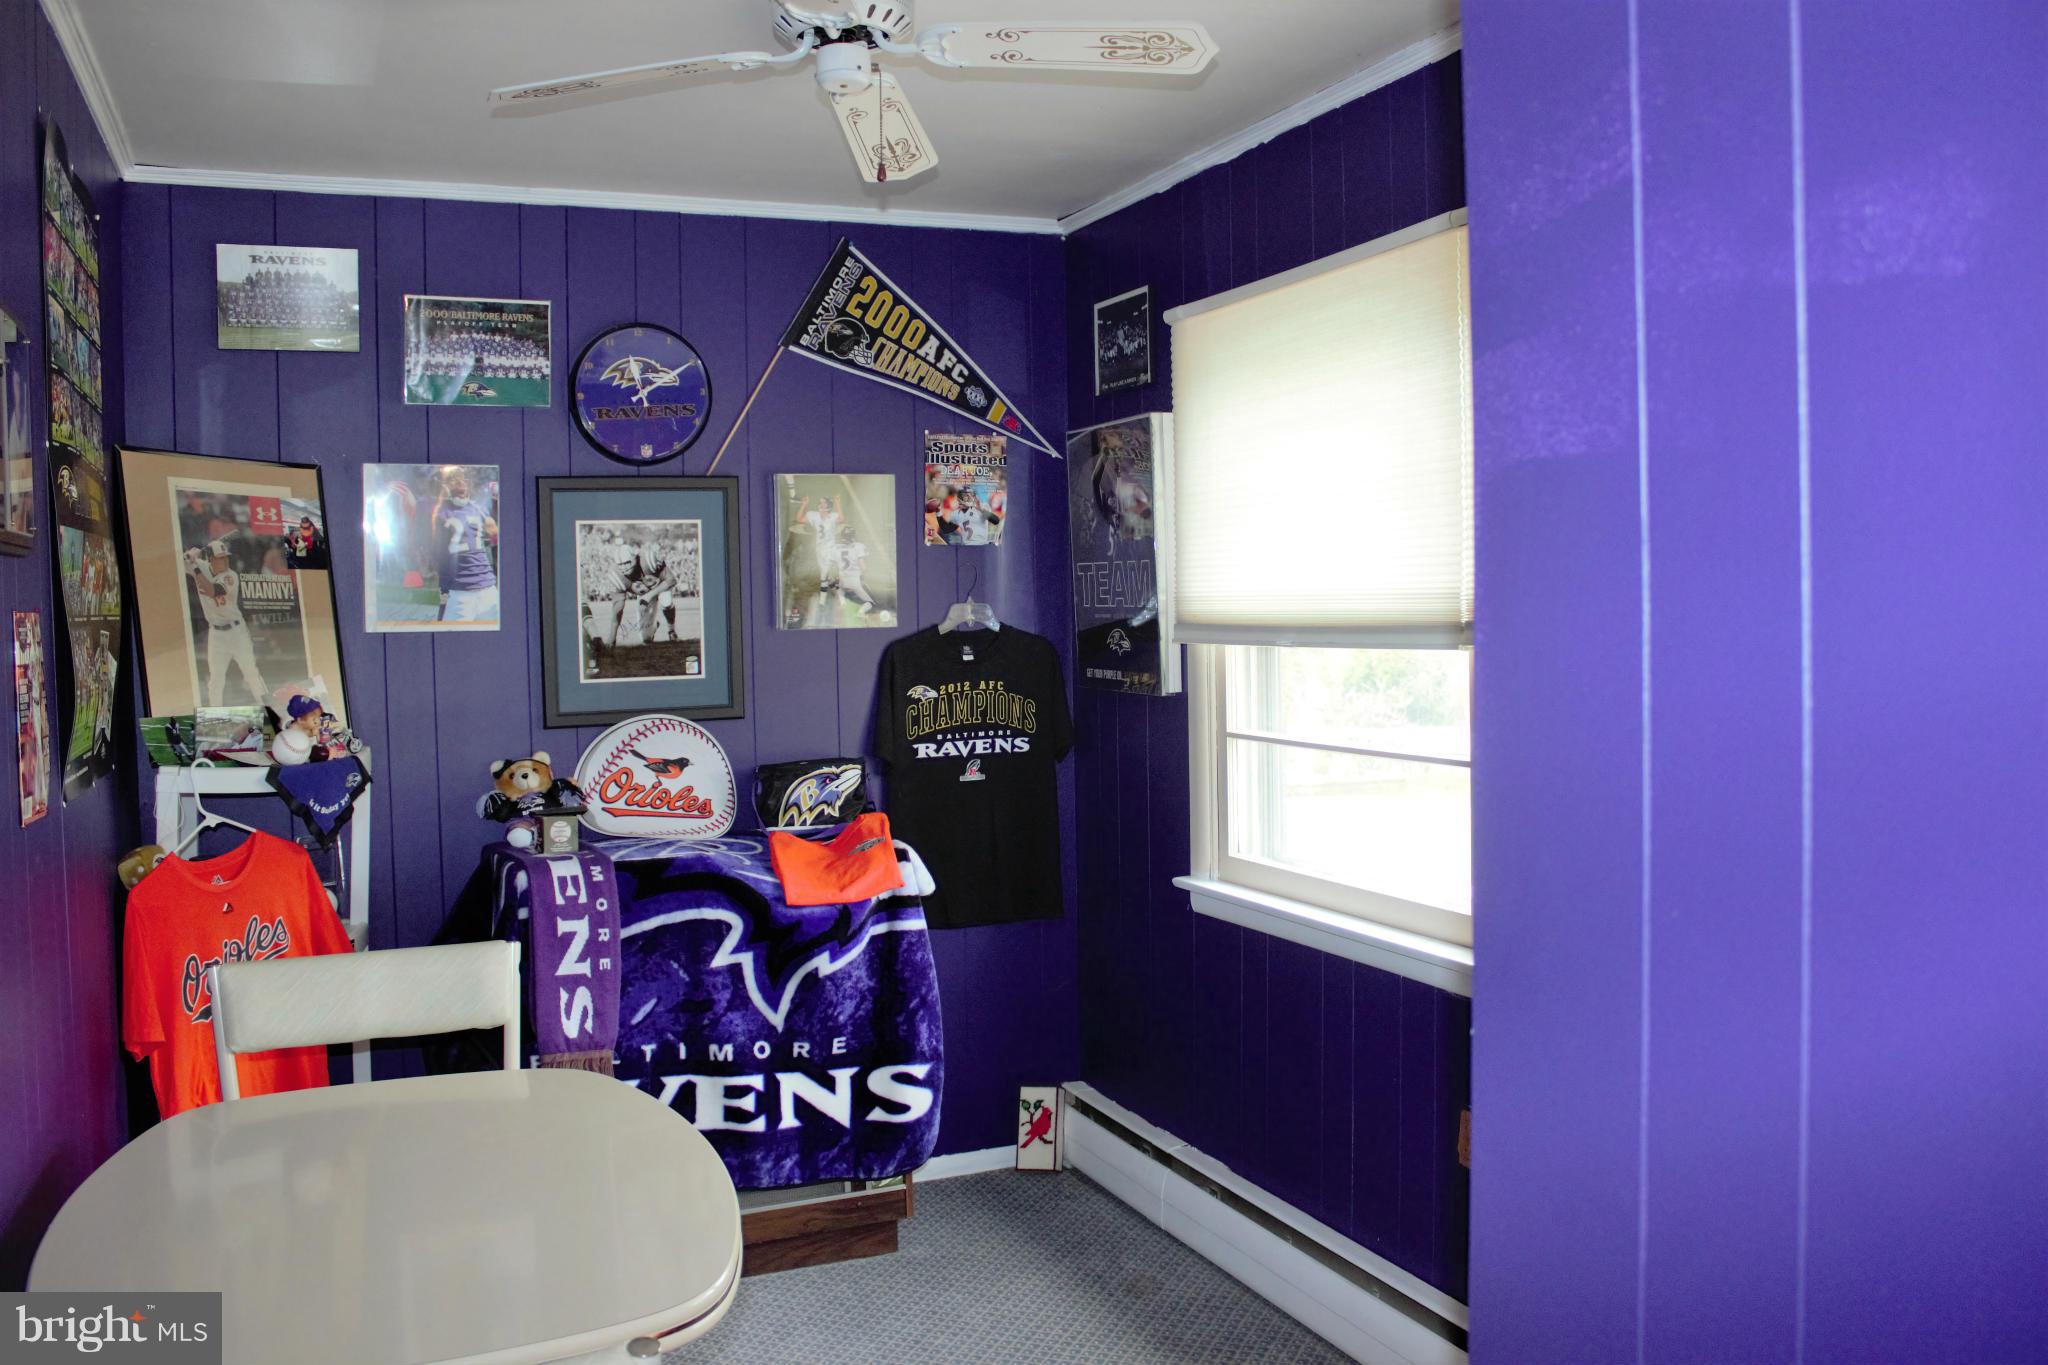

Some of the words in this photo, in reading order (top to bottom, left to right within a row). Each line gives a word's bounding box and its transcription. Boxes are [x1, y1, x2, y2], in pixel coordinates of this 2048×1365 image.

[248, 254, 328, 266] RAVENS
[800, 256, 856, 346] BALTIMORE
[807, 260, 864, 351] RAVENS
[451, 311, 500, 321] BALTIMORE
[502, 312, 535, 322] RAVENS
[845, 275, 927, 351] 2000
[916, 334, 969, 384] AFC
[870, 336, 961, 401] CHAMPIONS
[592, 403, 697, 421] RAVENS
[931, 440, 988, 455] Sports
[926, 451, 1008, 467] Illustrated
[241, 581, 295, 600] MANNY!
[1077, 559, 1152, 608] TEAM
[940, 681, 970, 694] 2012
[979, 680, 1004, 690] AFC
[906, 690, 1037, 740] CHAMPIONS
[937, 729, 1011, 740] BALTIMORE
[912, 737, 1031, 758] RAVENS
[599, 766, 714, 816] Orioles
